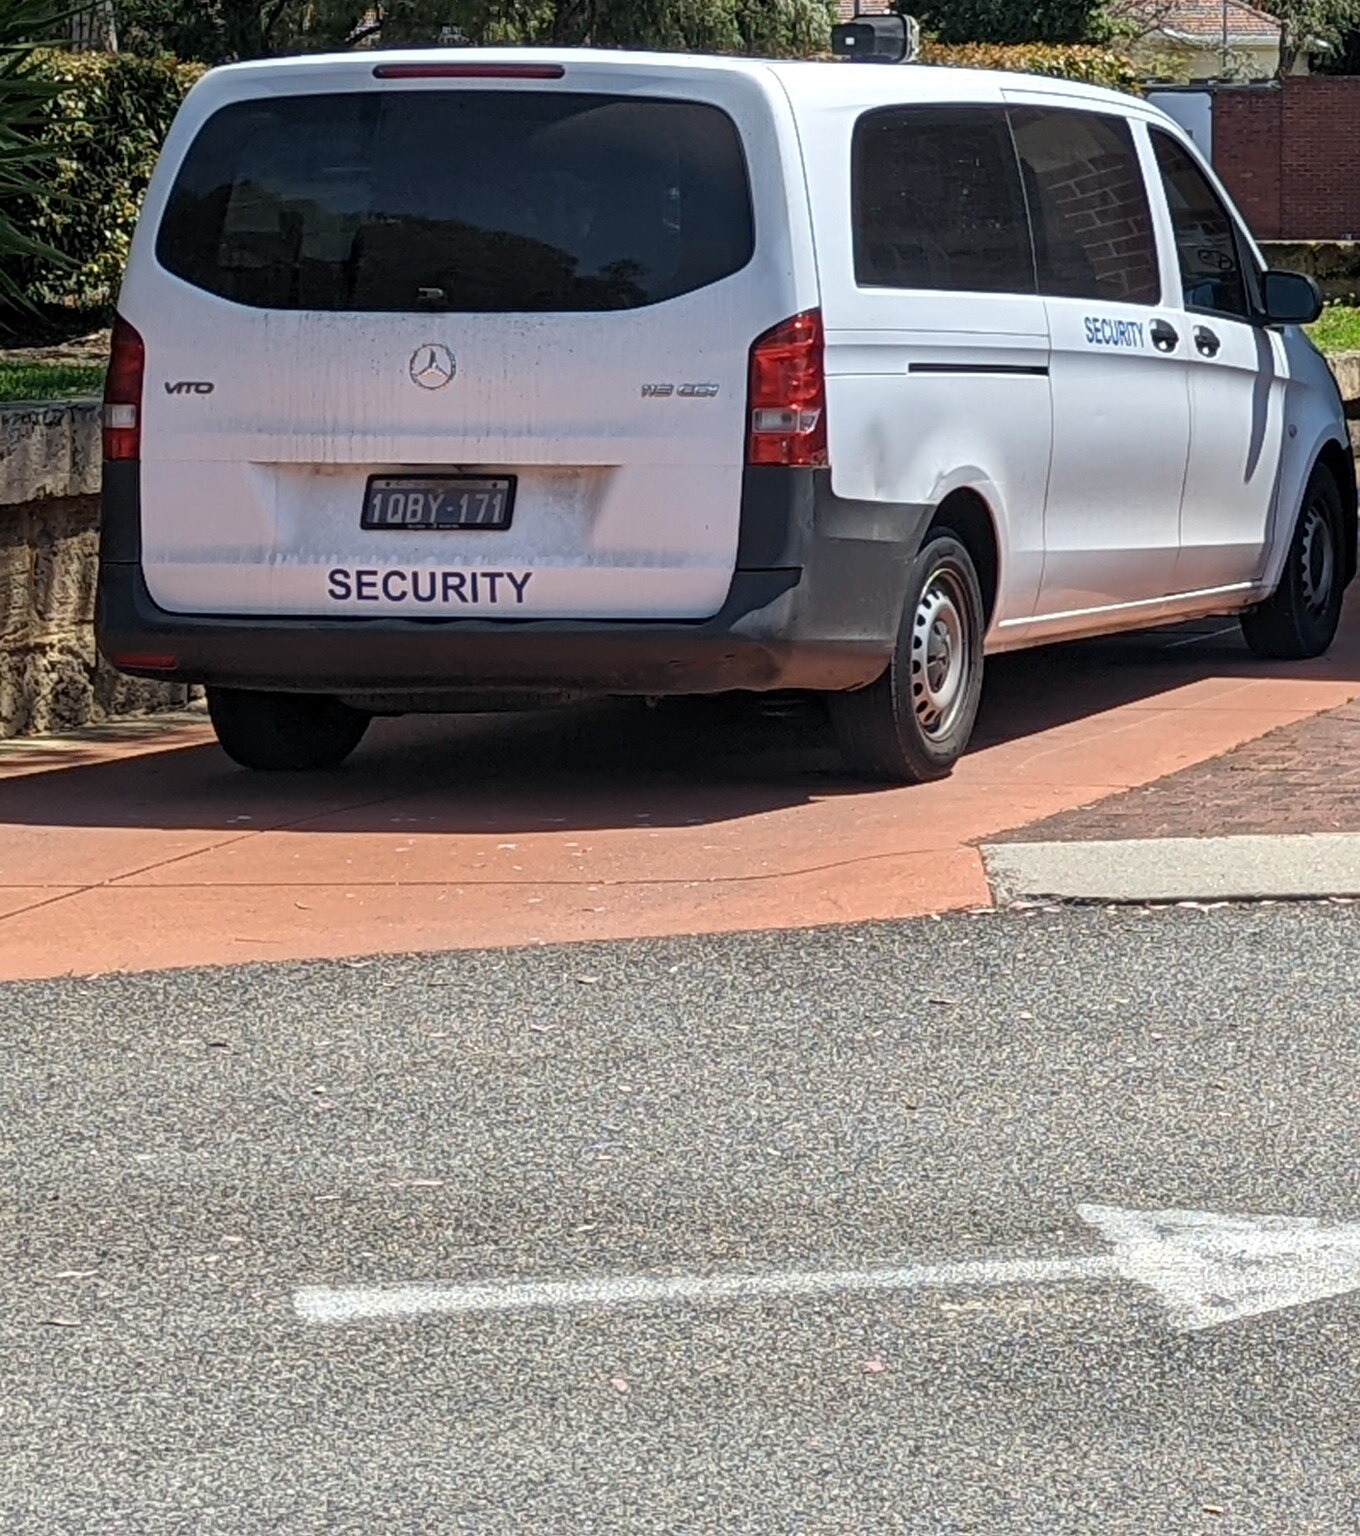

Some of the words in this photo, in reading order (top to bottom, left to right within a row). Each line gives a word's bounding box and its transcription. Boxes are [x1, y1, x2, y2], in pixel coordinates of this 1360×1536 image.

[1083, 316, 1146, 349] SECURITY
[164, 381, 215, 395] VITO
[327, 568, 533, 604] SECURITY
